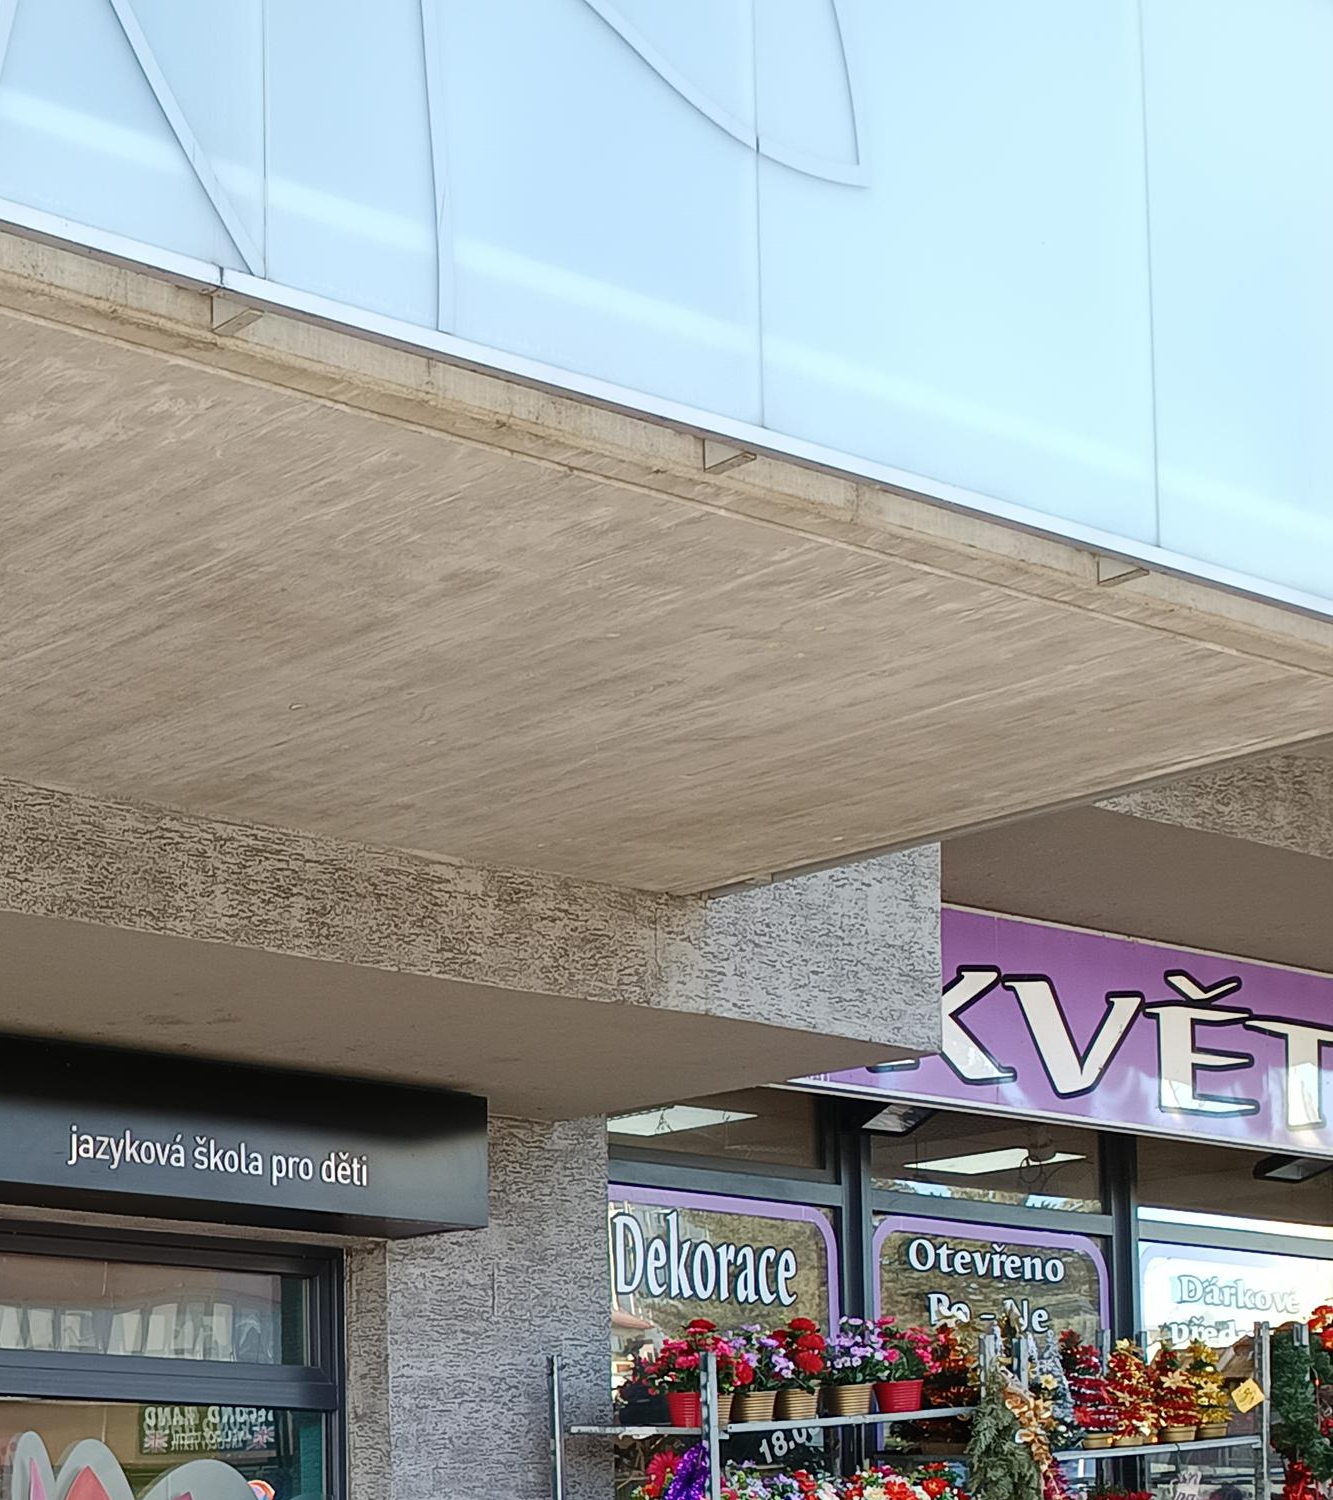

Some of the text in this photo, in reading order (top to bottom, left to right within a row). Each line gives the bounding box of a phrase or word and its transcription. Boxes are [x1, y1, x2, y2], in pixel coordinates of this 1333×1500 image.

[67, 1125, 369, 1187] jazyková škola pro děti
[611, 1210, 799, 1307] Dekorace
[908, 1237, 1066, 1284] Otevřeno
